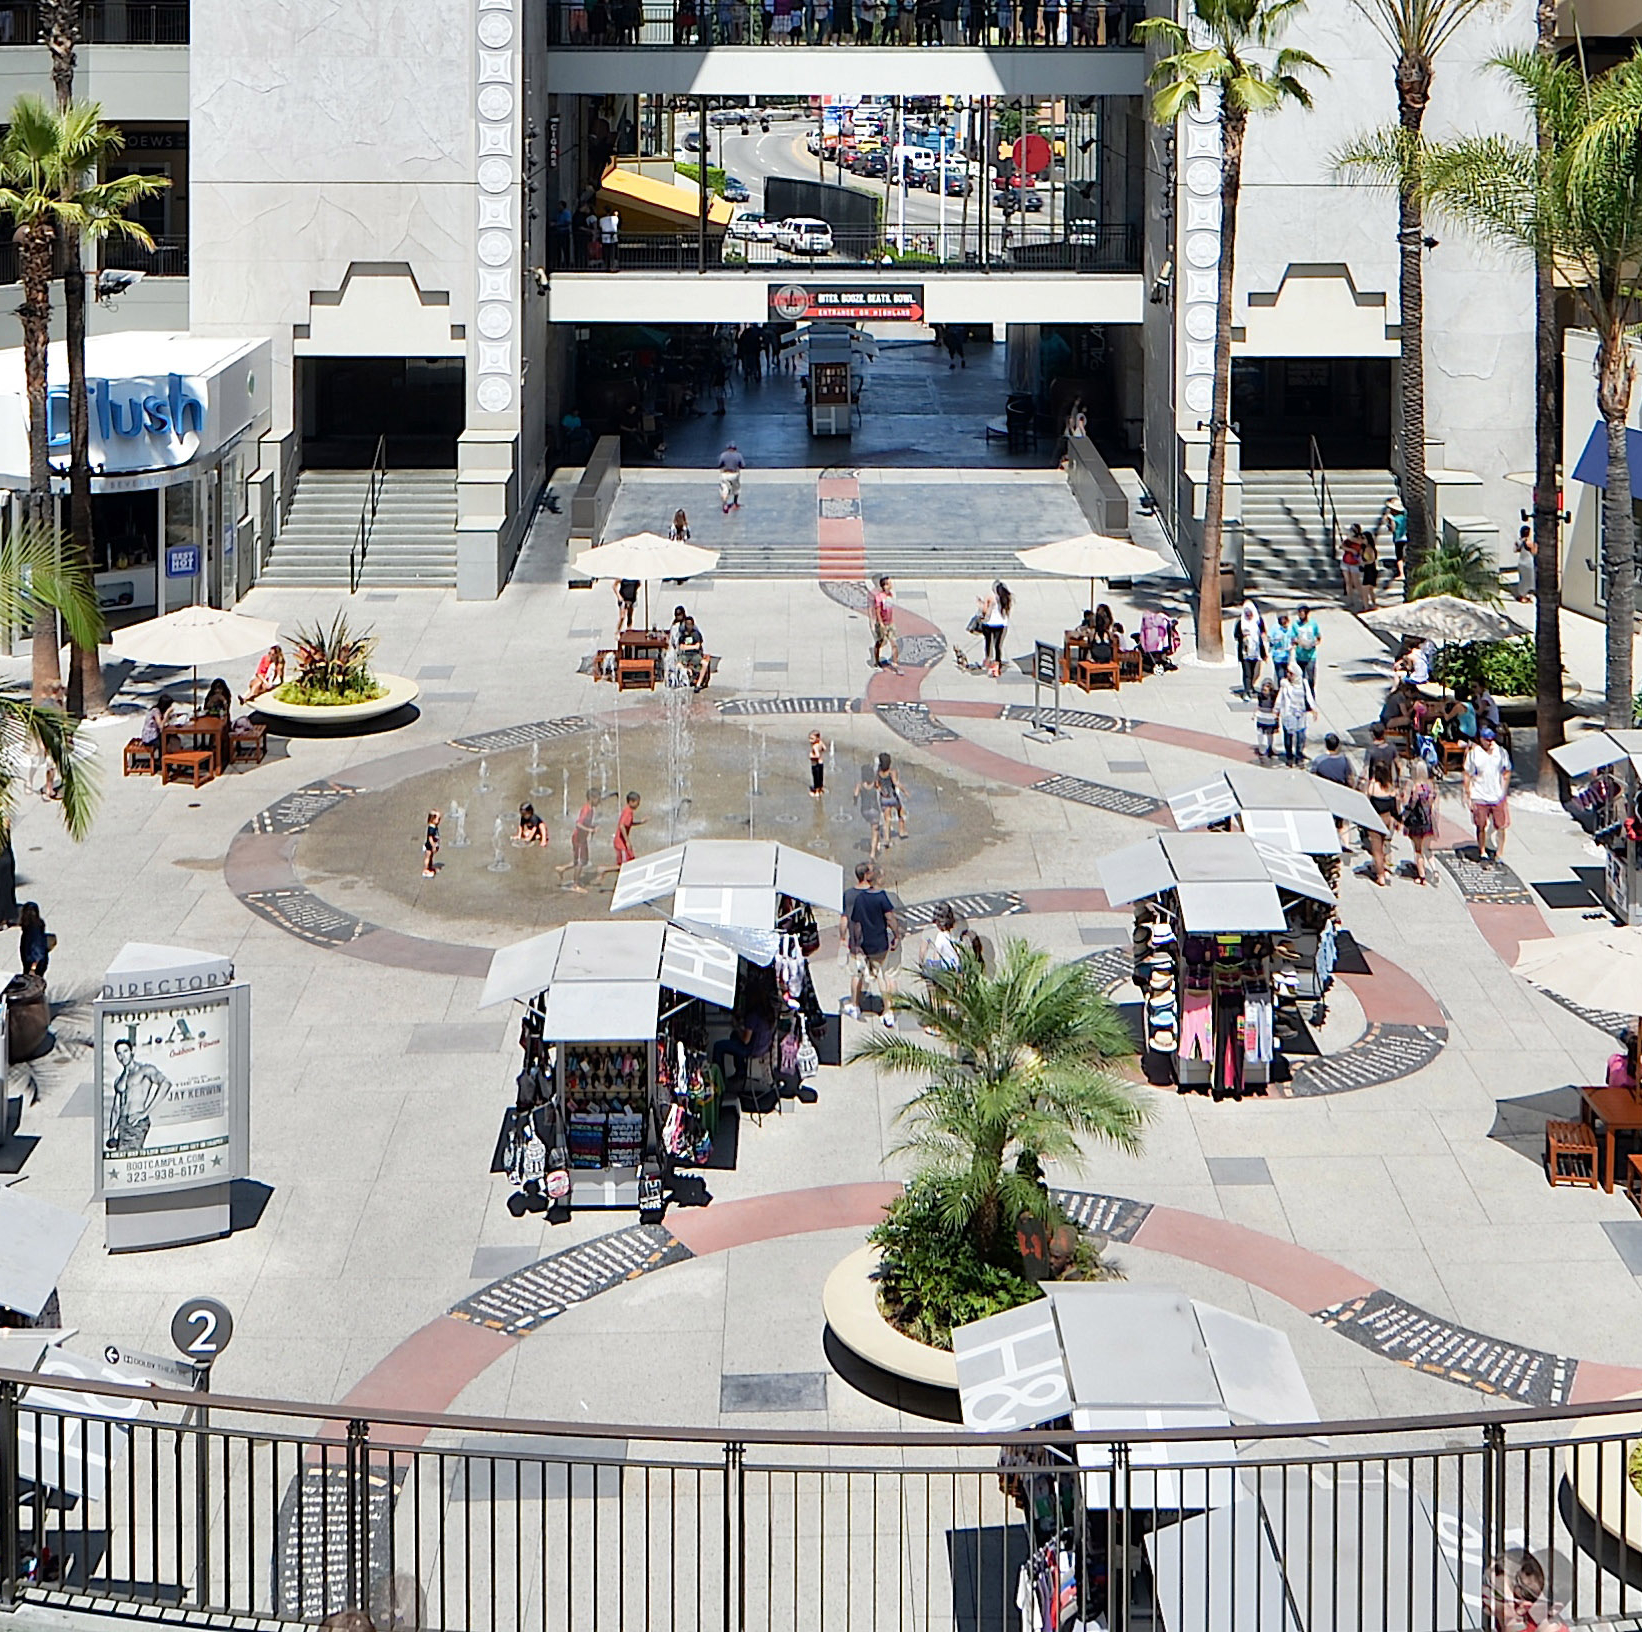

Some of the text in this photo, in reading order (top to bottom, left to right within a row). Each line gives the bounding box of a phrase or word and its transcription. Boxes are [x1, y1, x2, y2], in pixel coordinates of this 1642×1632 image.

[125, 134, 173, 148] OEWS
[818, 307, 911, 317] ENTRANCE ON HIGHLAND
[102, 971, 233, 999] DIRECTORY
[168, 1083, 222, 1103] JAY KERWIN
[126, 1153, 205, 1172] BOOTCAMPLA.COM
[126, 1165, 205, 1184] 323-938-6179
[187, 1309, 217, 1352] 2
[134, 1356, 155, 1369] DOLBY
